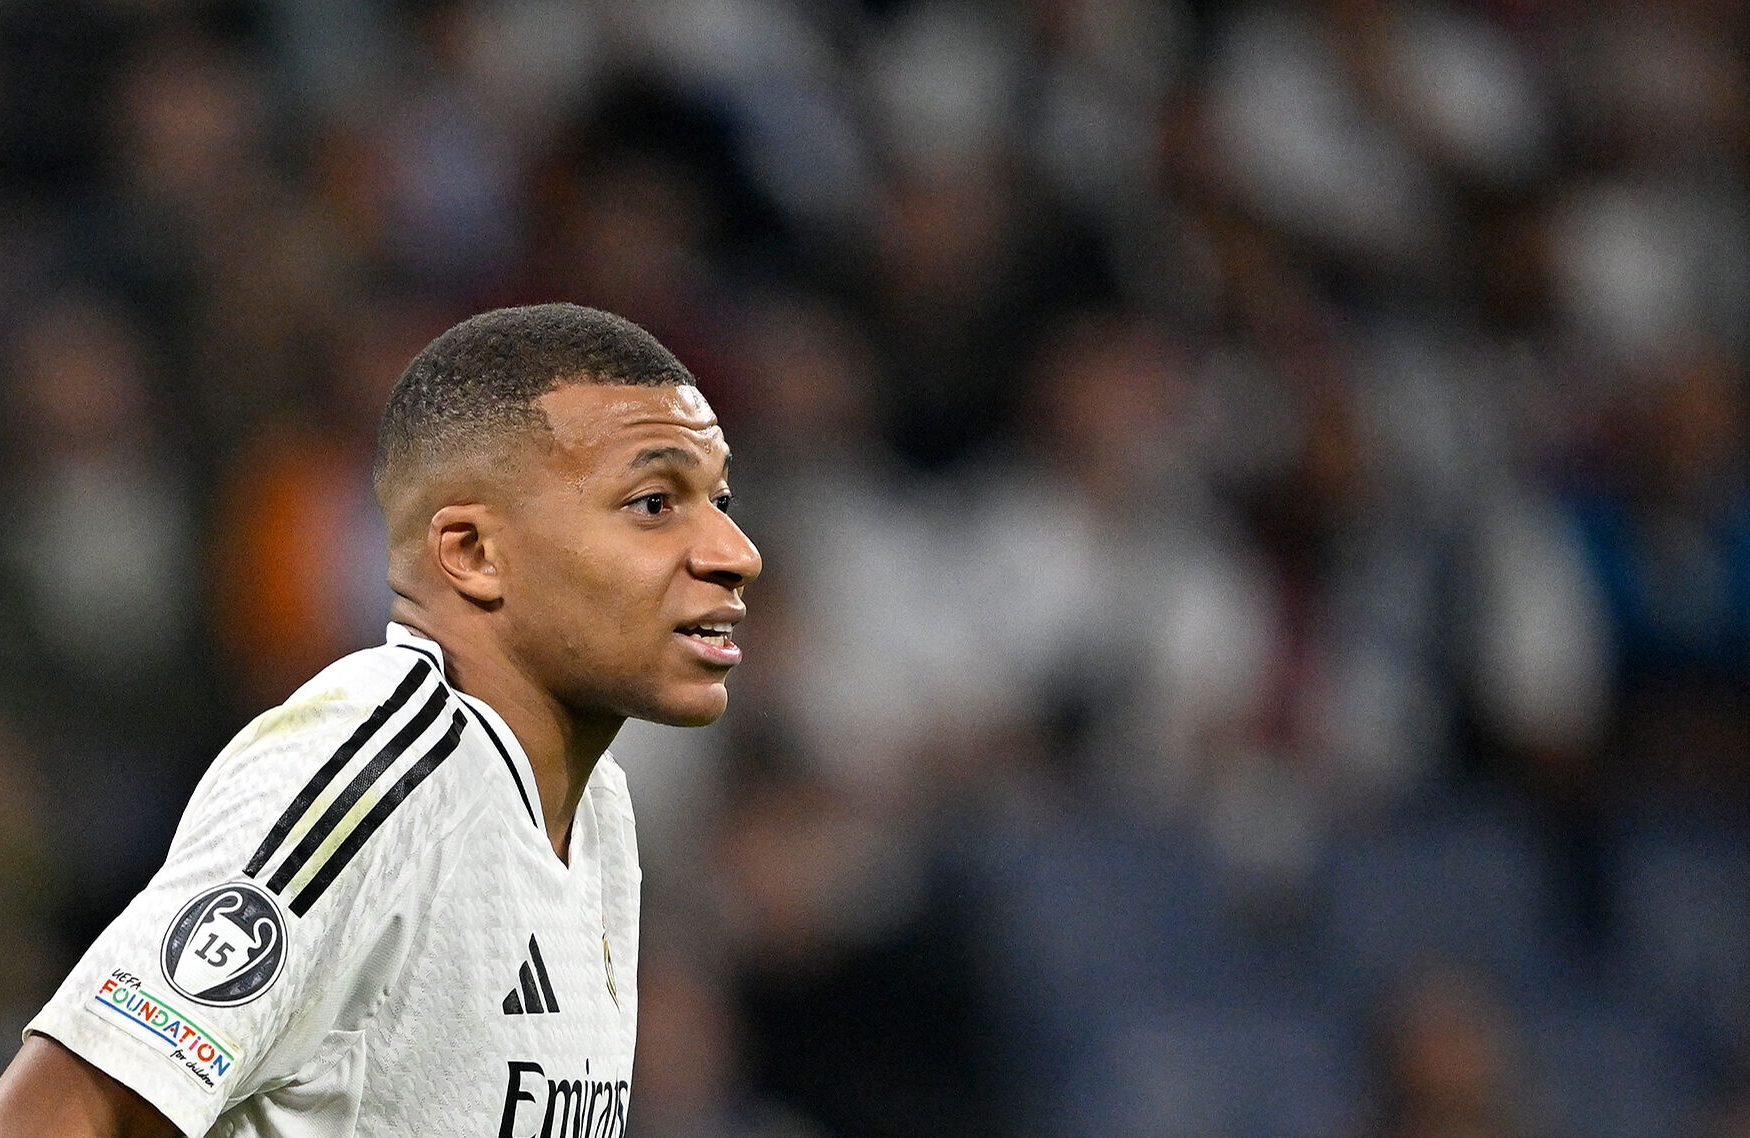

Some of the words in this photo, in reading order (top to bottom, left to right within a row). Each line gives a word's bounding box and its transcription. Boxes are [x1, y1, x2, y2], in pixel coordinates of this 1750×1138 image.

[194, 932, 236, 968] 15
[111, 967, 143, 990] UEFA
[98, 978, 231, 1077] FOUNDATION
[170, 1048, 187, 1062] for
[185, 1060, 216, 1089] children
